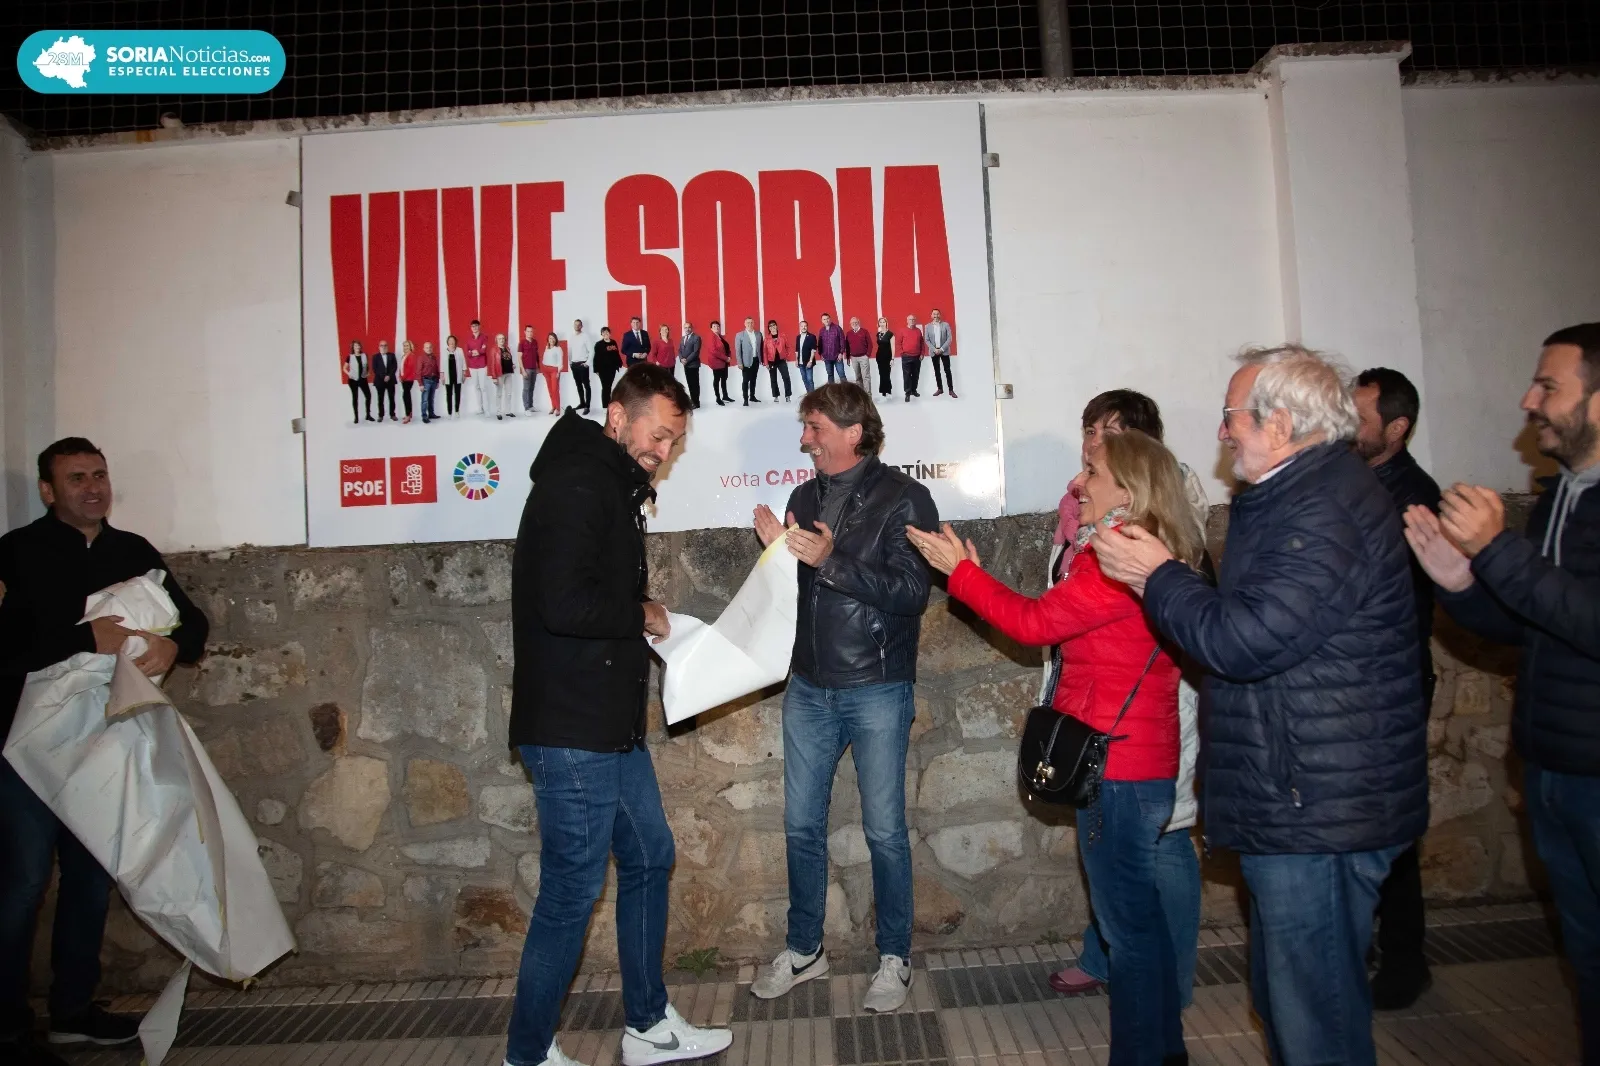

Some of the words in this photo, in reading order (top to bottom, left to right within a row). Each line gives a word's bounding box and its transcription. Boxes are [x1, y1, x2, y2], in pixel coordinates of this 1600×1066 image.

[330, 181, 568, 384] VIVE
[605, 165, 957, 368] SORIA
[342, 464, 363, 474] Soria
[720, 472, 760, 488] vota
[343, 480, 384, 497] PSOE
